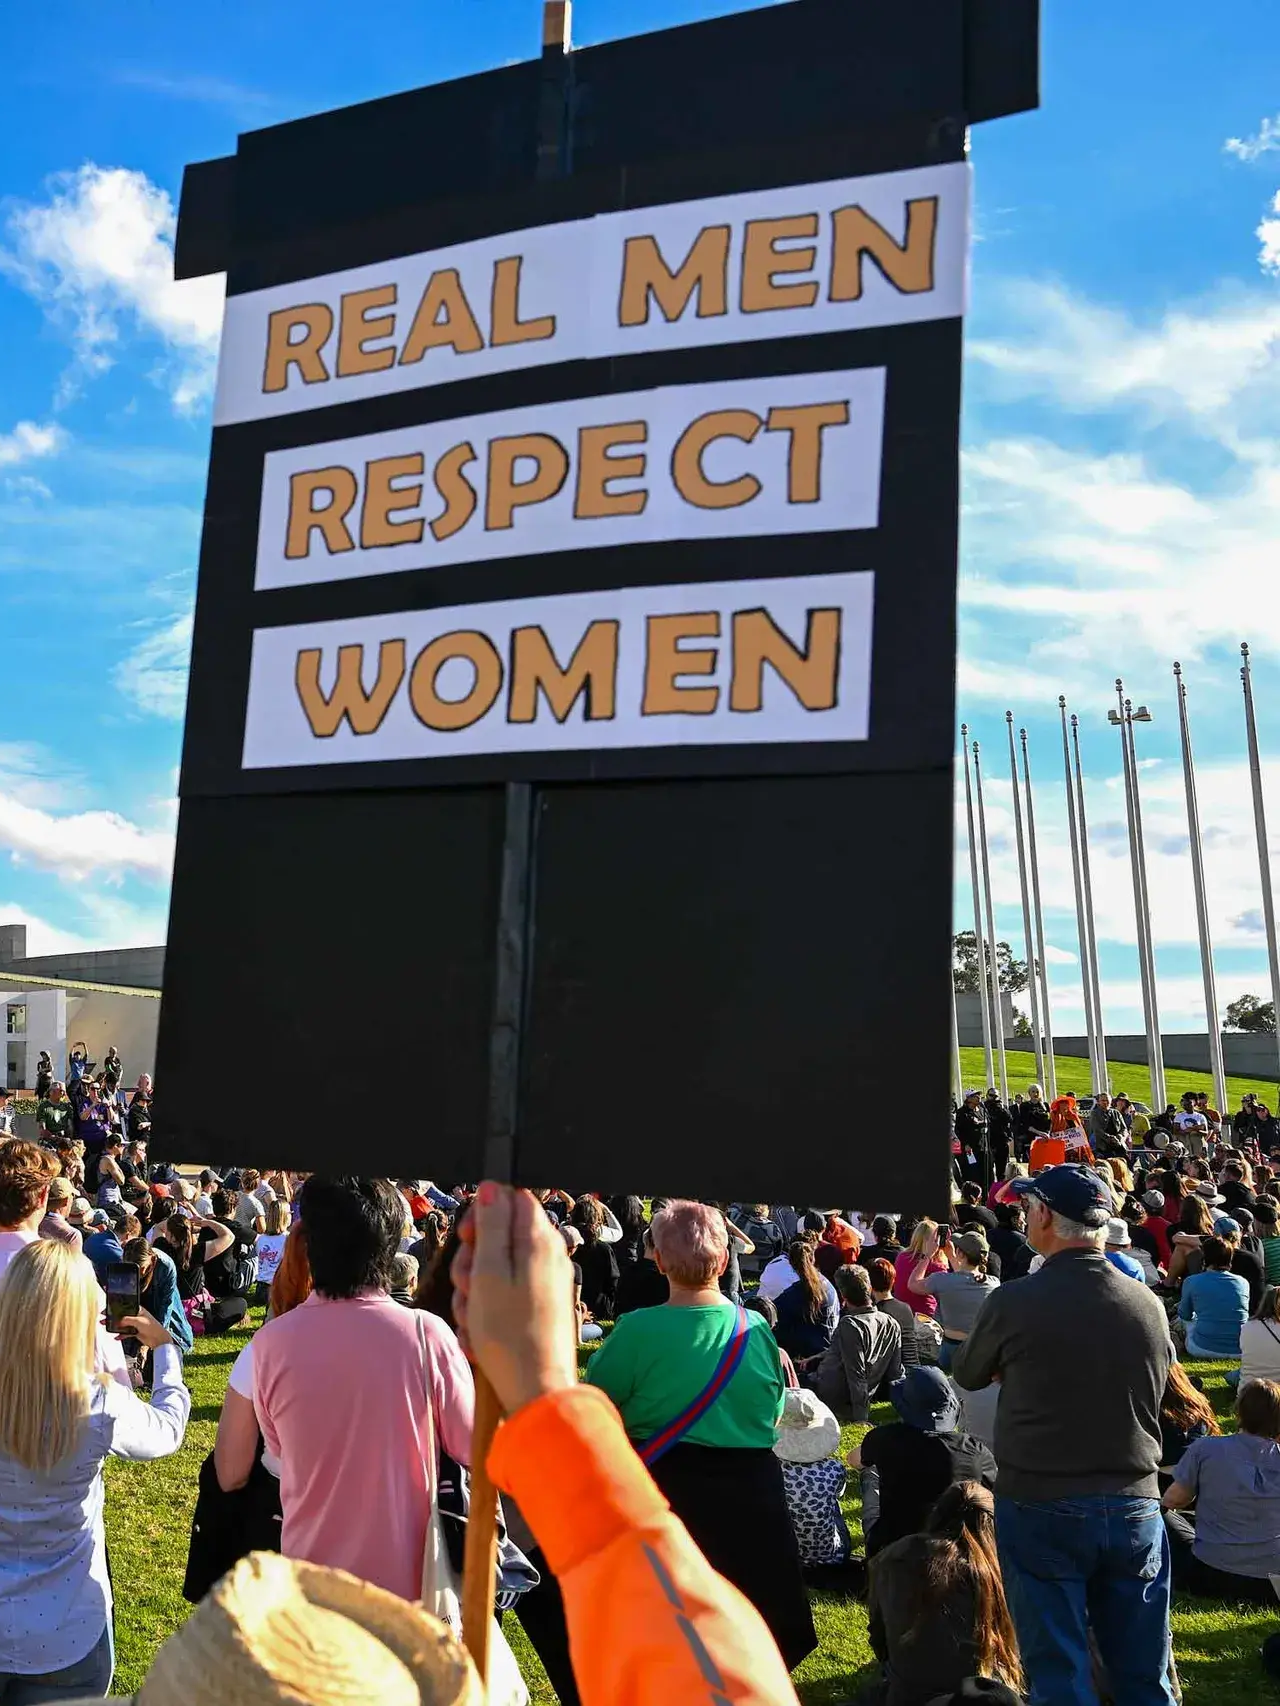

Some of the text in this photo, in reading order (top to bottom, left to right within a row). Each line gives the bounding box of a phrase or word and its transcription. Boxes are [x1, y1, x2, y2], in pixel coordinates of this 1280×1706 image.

[262, 197, 938, 393] REAL MEN
[284, 400, 851, 560] RESPECT
[294, 608, 842, 738] WOMEN
